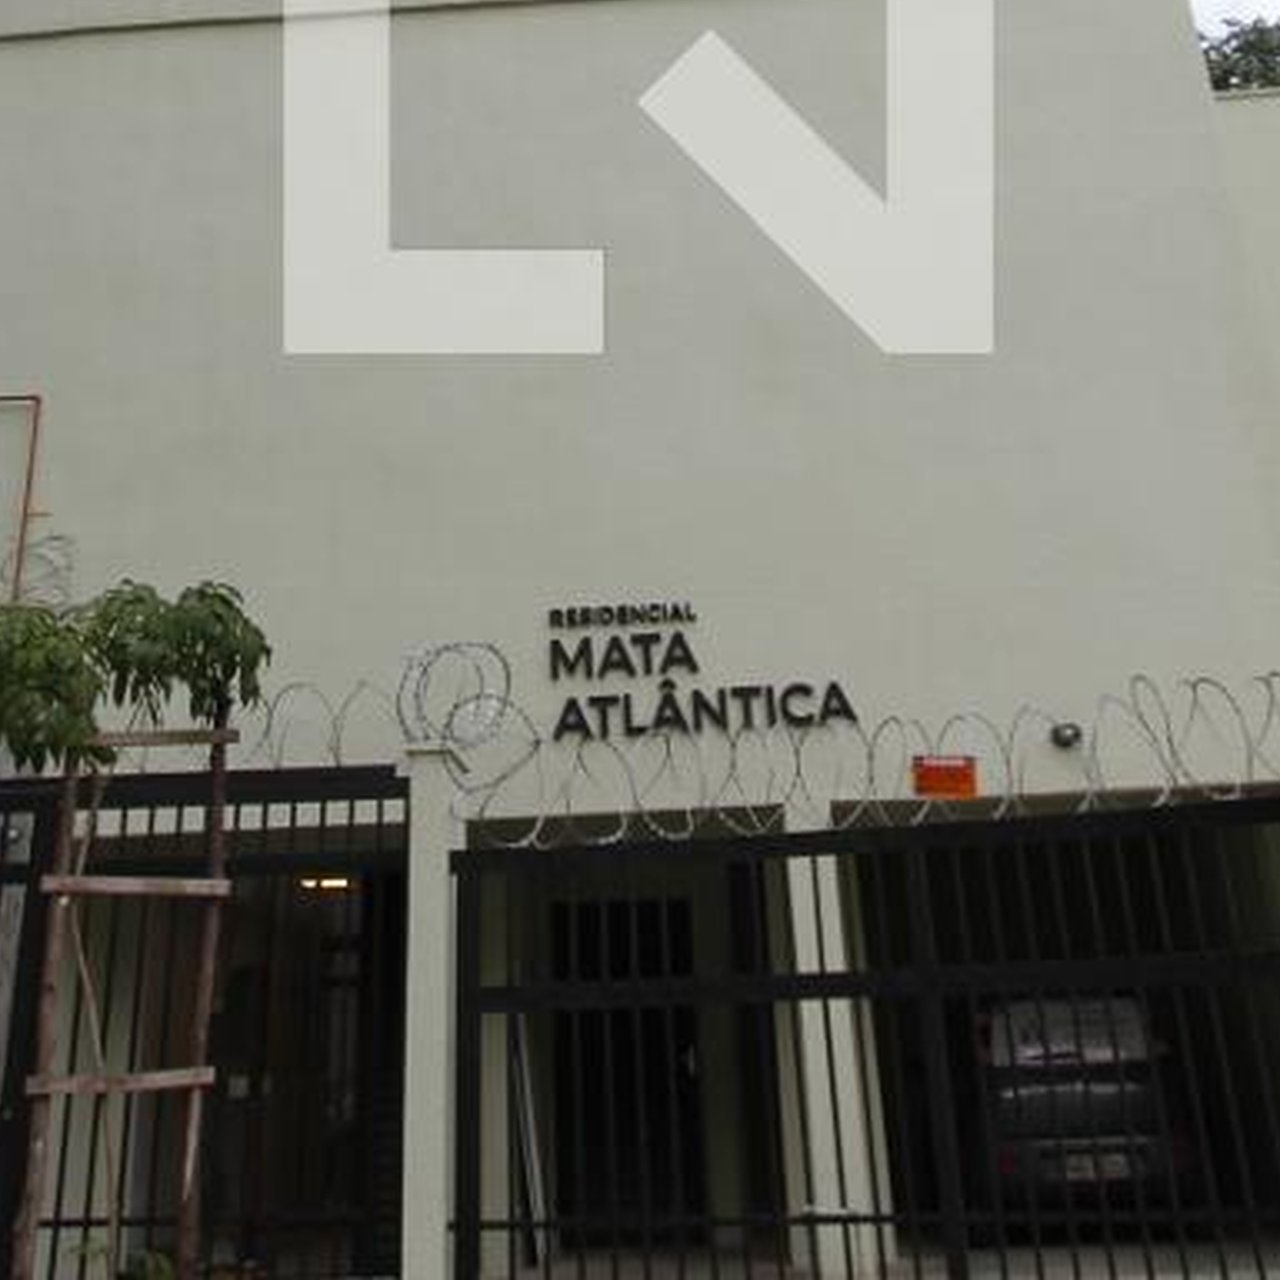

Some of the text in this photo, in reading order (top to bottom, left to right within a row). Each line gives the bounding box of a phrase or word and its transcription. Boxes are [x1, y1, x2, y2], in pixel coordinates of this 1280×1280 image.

[549, 602, 697, 629] RESIDENCIAL
[549, 631, 699, 681] MATA
[553, 677, 858, 741] ATLÂNTICA
